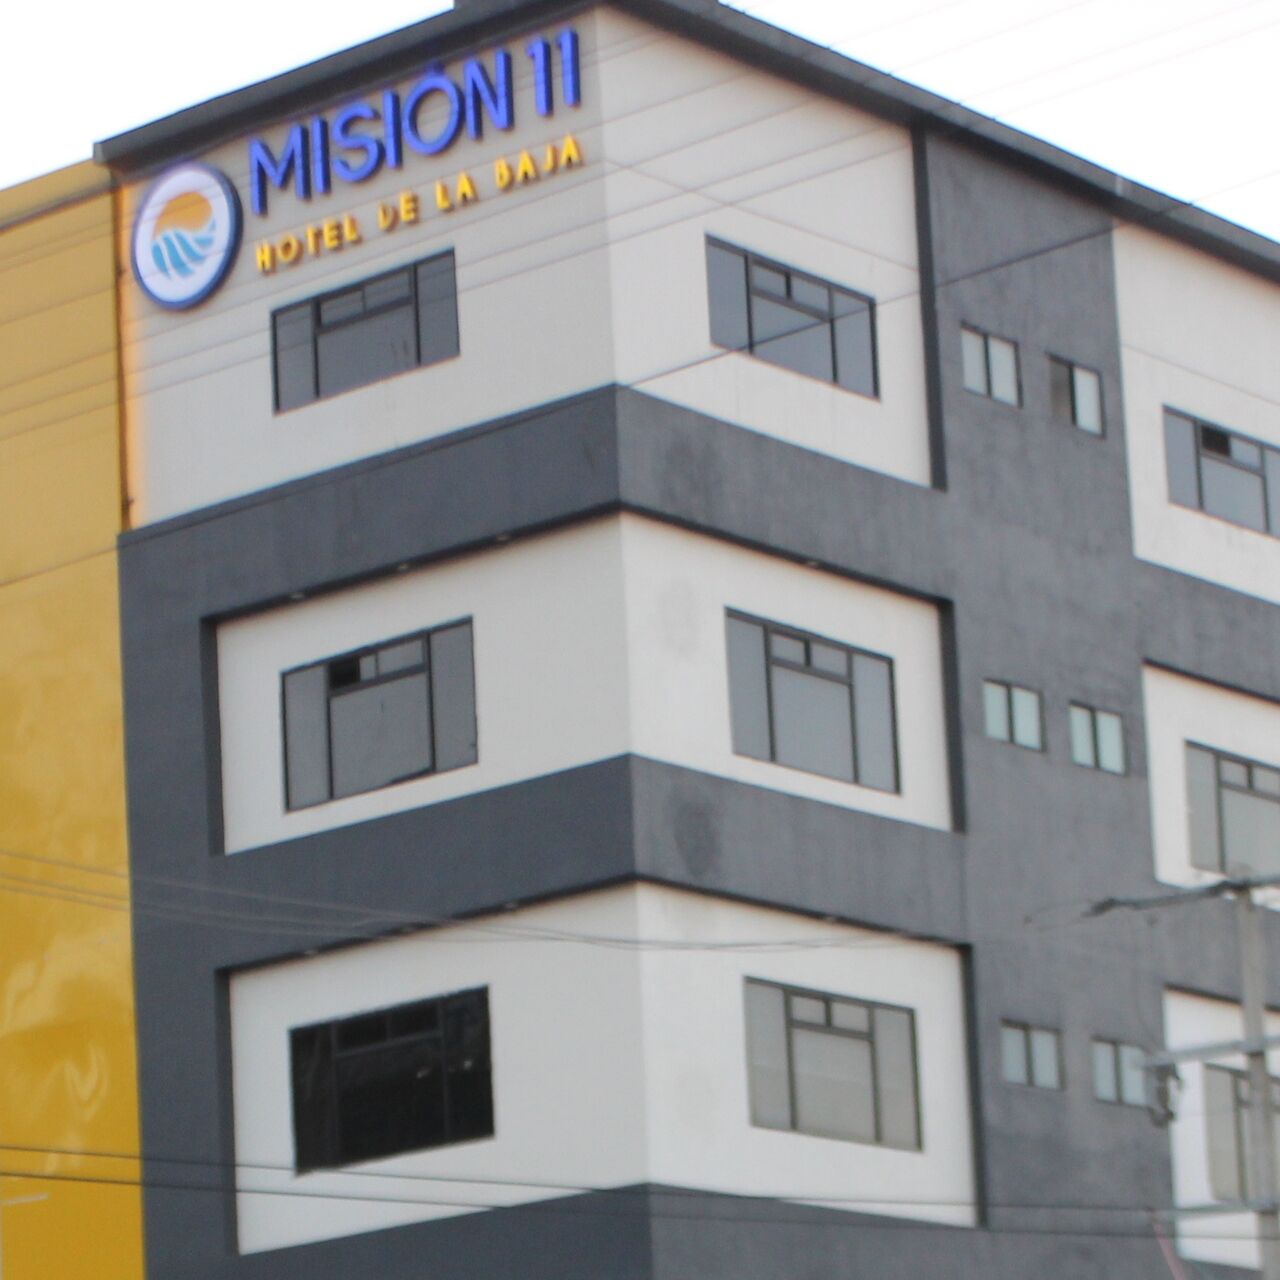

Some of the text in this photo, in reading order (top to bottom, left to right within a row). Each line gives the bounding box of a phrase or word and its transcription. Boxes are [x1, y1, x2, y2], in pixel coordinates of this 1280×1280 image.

[255, 133, 583, 274] HOTEL DE LA BAJA
